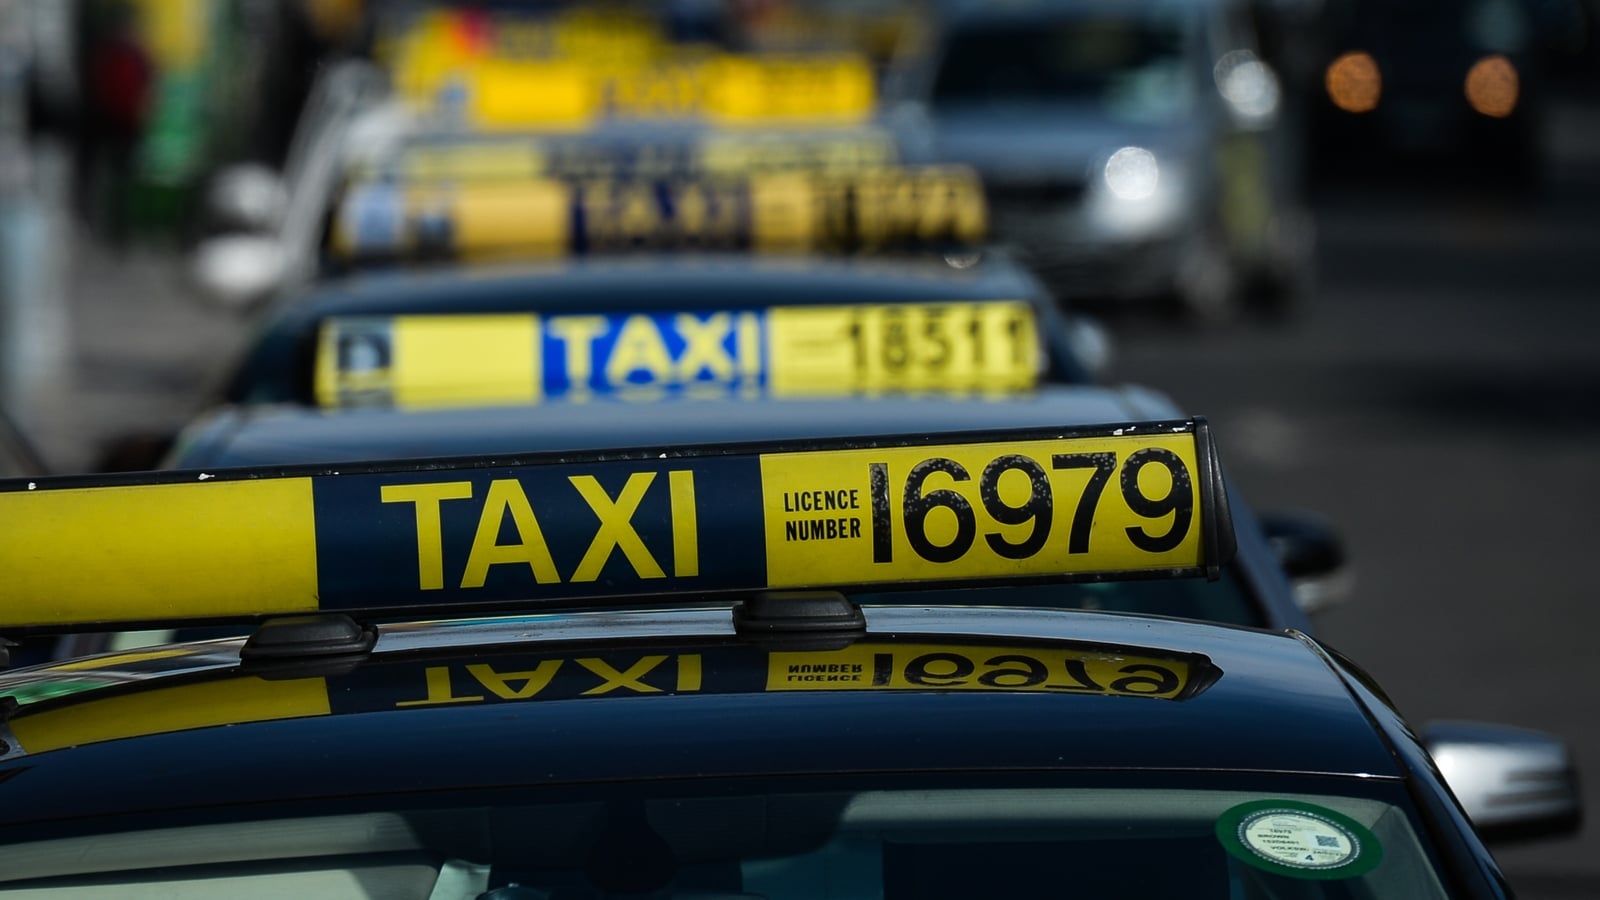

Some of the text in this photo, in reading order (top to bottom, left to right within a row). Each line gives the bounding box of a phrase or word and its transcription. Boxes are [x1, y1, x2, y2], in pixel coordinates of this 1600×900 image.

[547, 313, 761, 387] TAXI
[848, 306, 1026, 373] 18511
[380, 470, 699, 590] TAXI
[783, 489, 860, 513] LICENCE
[785, 517, 862, 542] NUMBER
[868, 447, 1195, 564] 16979
